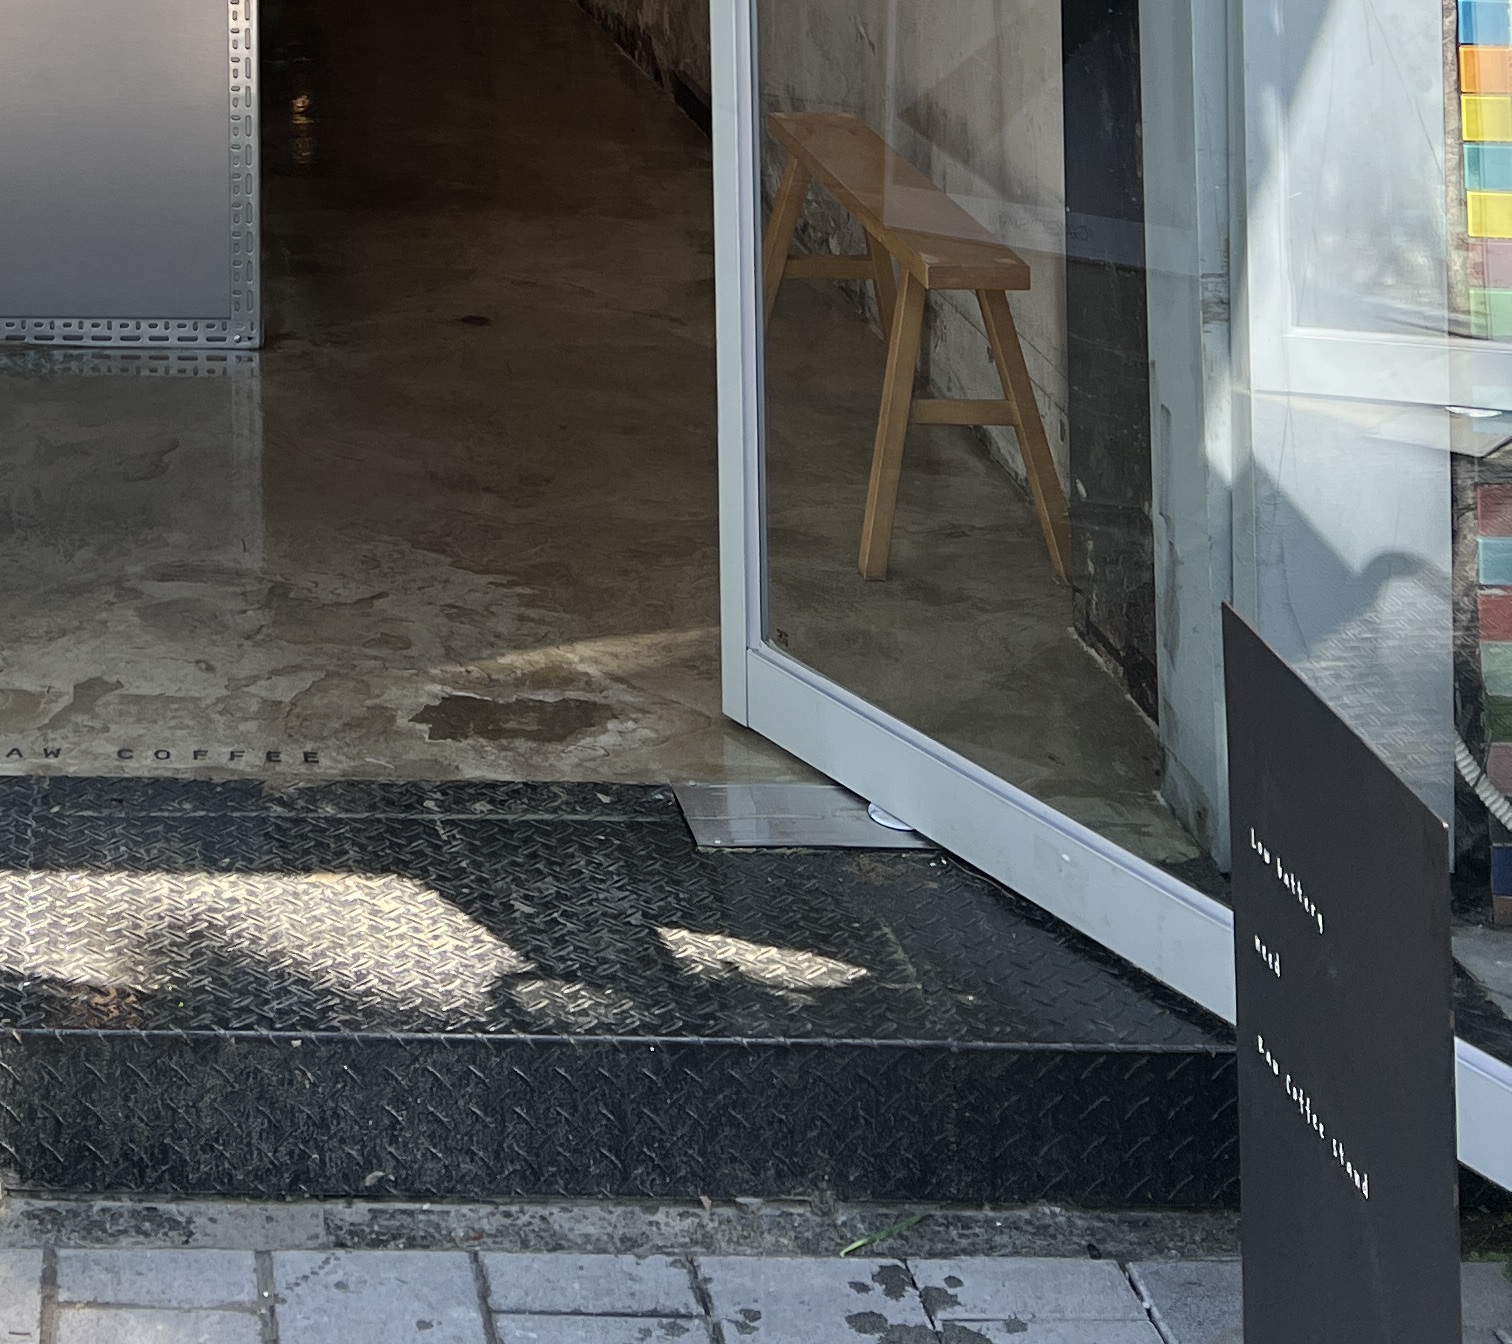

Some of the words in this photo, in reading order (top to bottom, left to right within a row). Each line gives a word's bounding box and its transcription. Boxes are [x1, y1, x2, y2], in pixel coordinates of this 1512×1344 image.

[116, 748, 321, 764] COFFEE
[1249, 826, 1271, 864] Low
[1276, 856, 1325, 935] battery
[1254, 934, 1281, 978] need
[1257, 1034, 1280, 1076] Raw
[1286, 1074, 1325, 1139] Coffee
[1332, 1138, 1369, 1200] Stand
